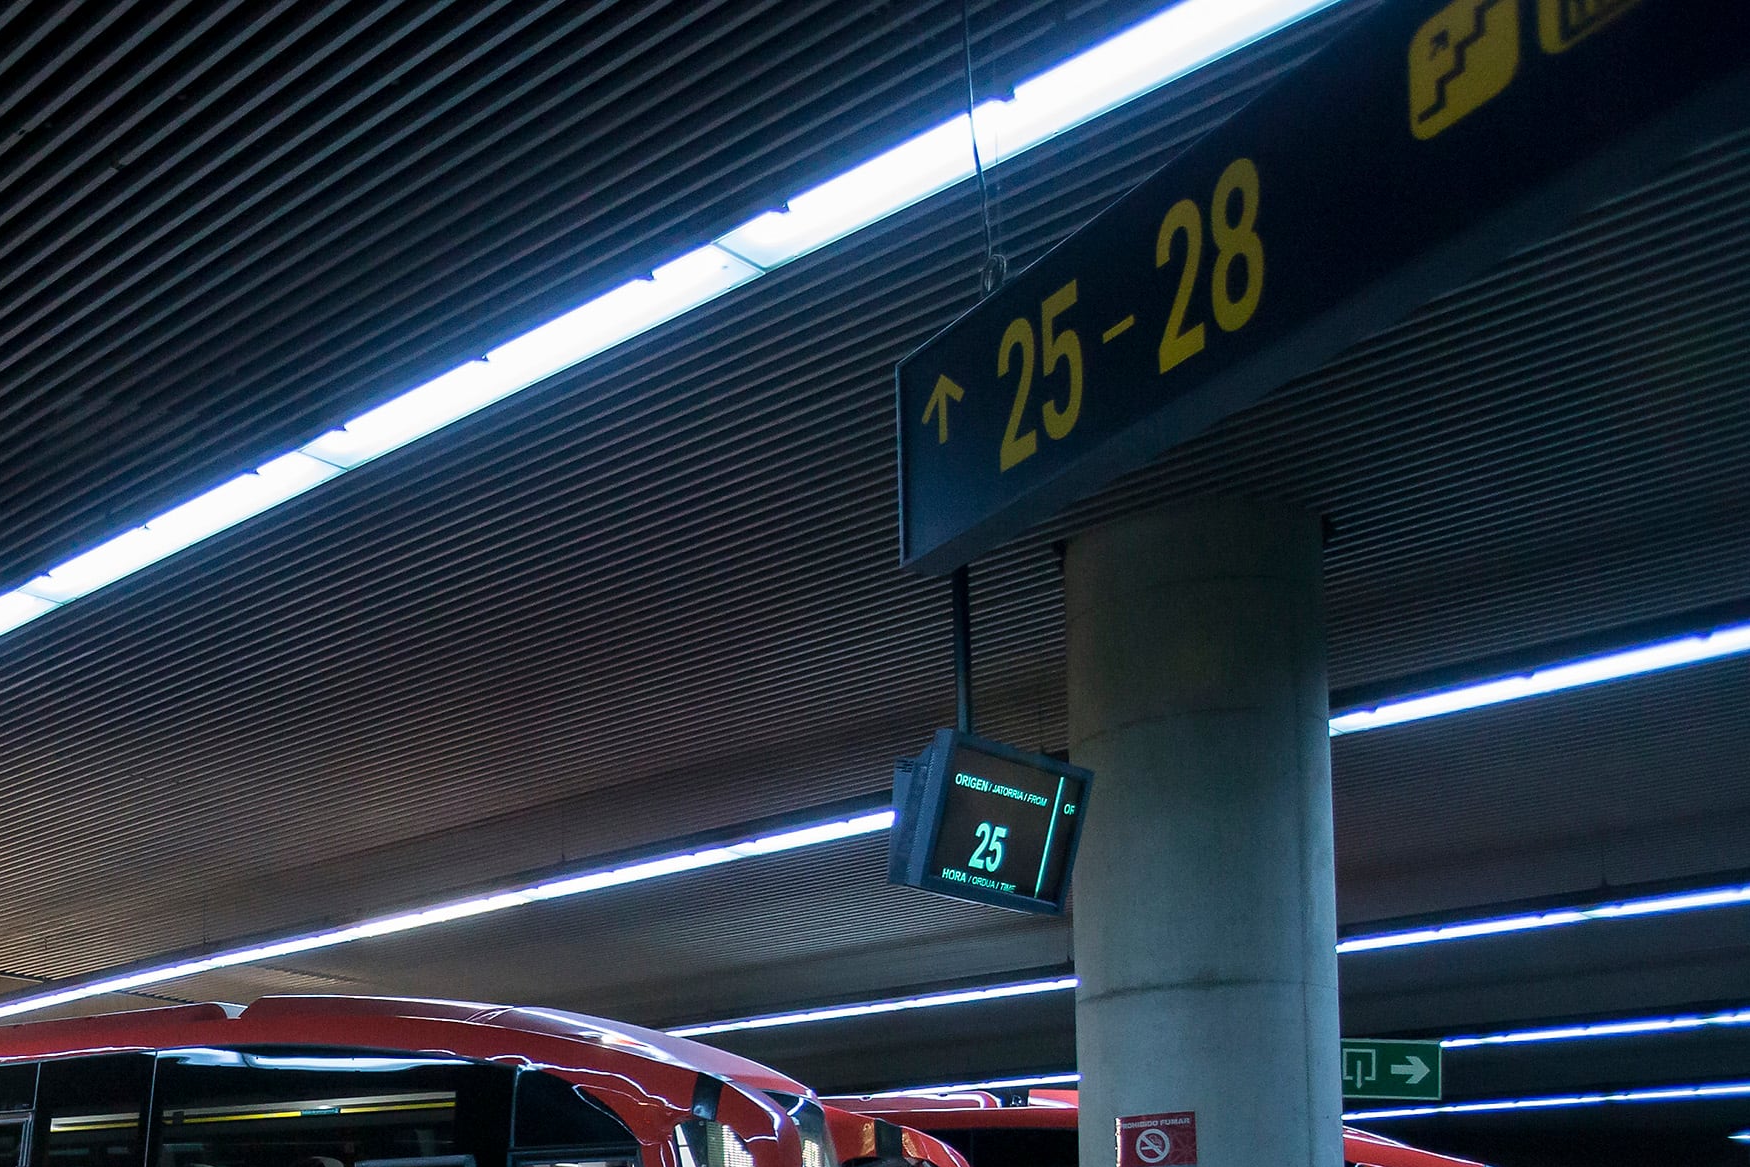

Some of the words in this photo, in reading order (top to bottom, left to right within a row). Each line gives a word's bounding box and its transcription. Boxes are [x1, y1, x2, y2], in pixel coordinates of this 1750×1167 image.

[998, 279, 1083, 473] 25
[1102, 314, 1135, 344] -
[1156, 158, 1265, 375] 28
[955, 773, 988, 793] ORIGEN
[992, 784, 1024, 801] JATORRIA
[1027, 794, 1048, 807] FROM
[968, 822, 1008, 872] 25
[942, 868, 967, 883] HORA
[971, 876, 995, 890] ORDUA
[1160, 1117, 1191, 1126] FUMAR
